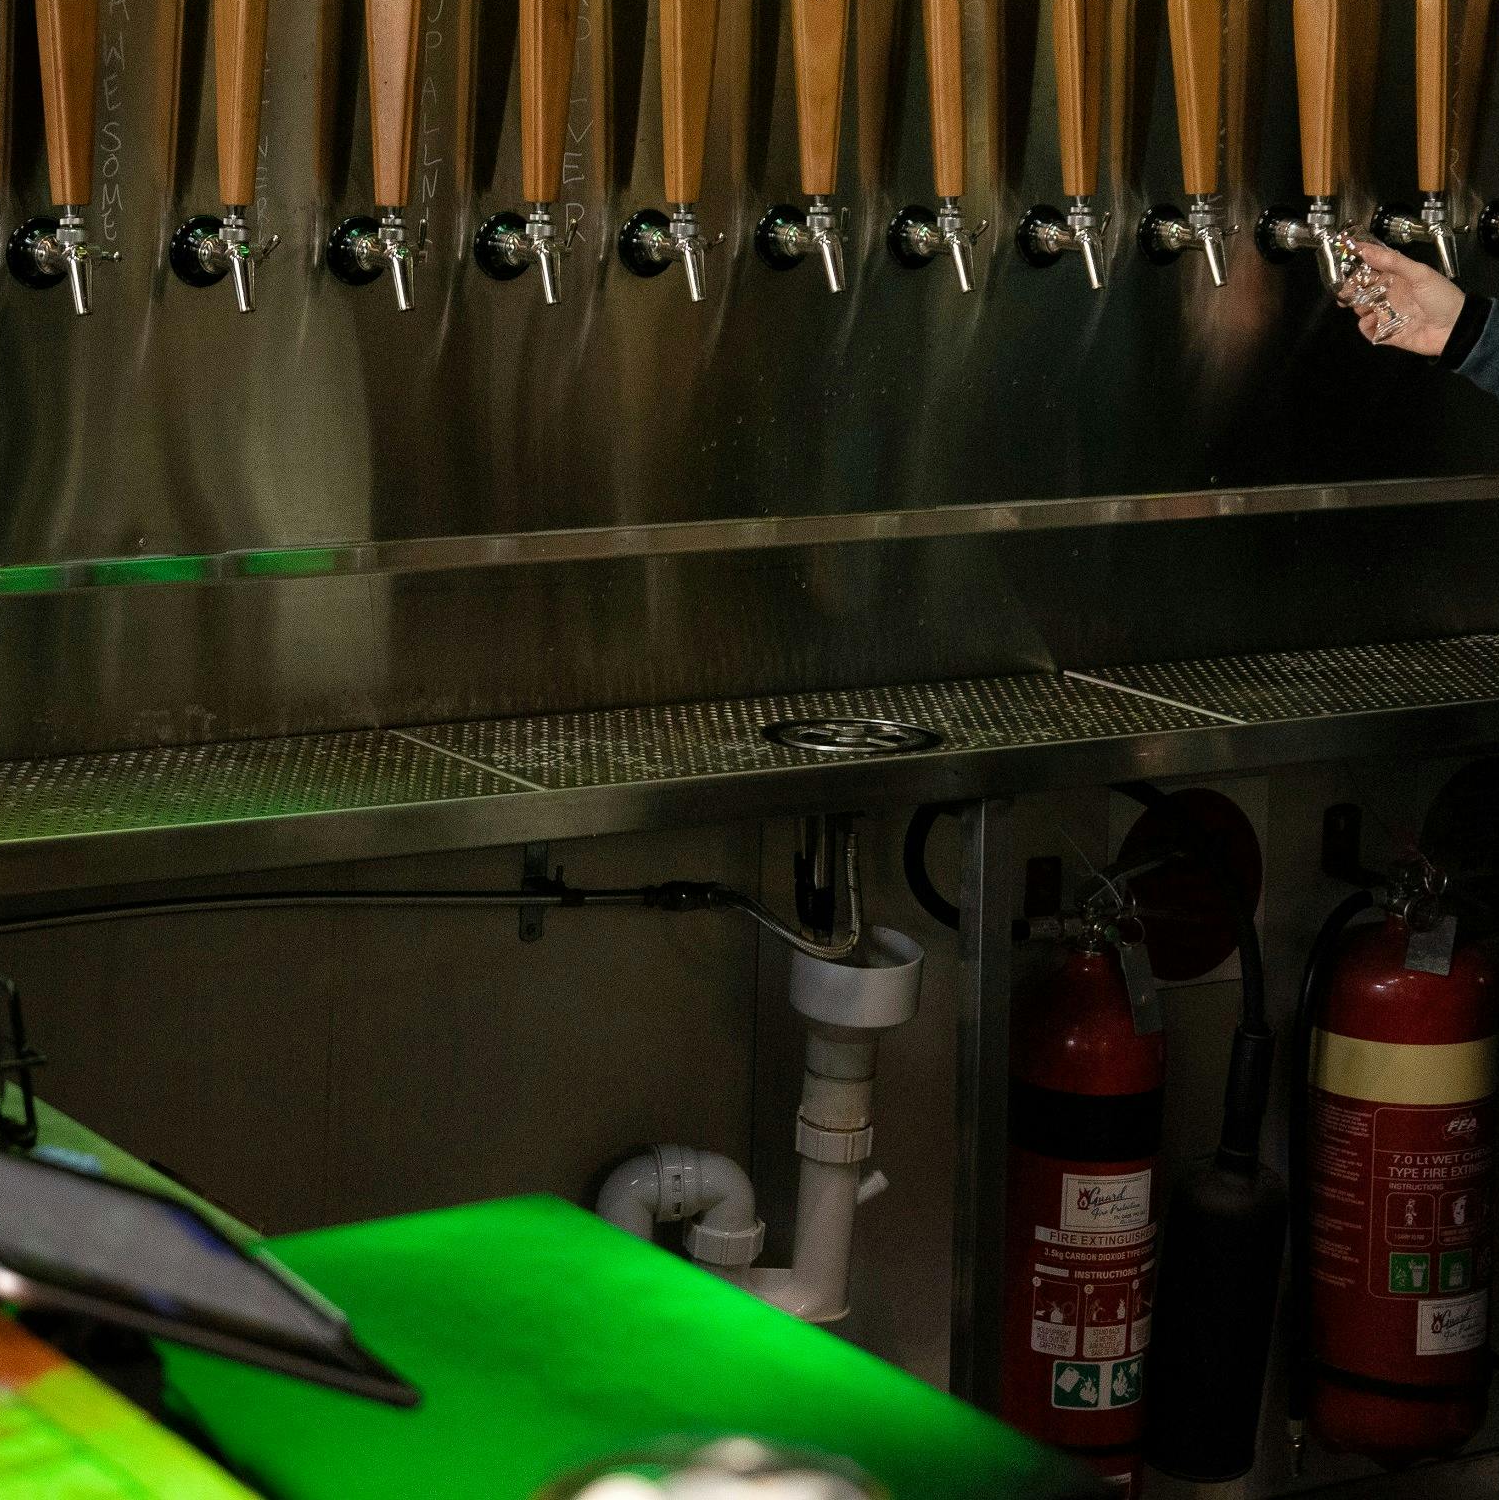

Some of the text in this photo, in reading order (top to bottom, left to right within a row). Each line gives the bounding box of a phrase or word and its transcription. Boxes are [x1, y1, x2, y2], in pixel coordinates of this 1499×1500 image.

[1392, 1154, 1413, 1164] 7.0
[1432, 1153, 1460, 1165] WET
[1388, 1166, 1419, 1178] TYPE
[1423, 1167, 1448, 1178] FIRE
[1389, 1182, 1444, 1192] INSTRUCTIONS
[1049, 1231, 1078, 1244] FIRE
[1044, 1247, 1064, 1261] 3.5kg
[1065, 1251, 1097, 1261] CARBON
[1098, 1250, 1126, 1261] DIOXIDE
[1074, 1266, 1139, 1280] INSTRUCTIONS
